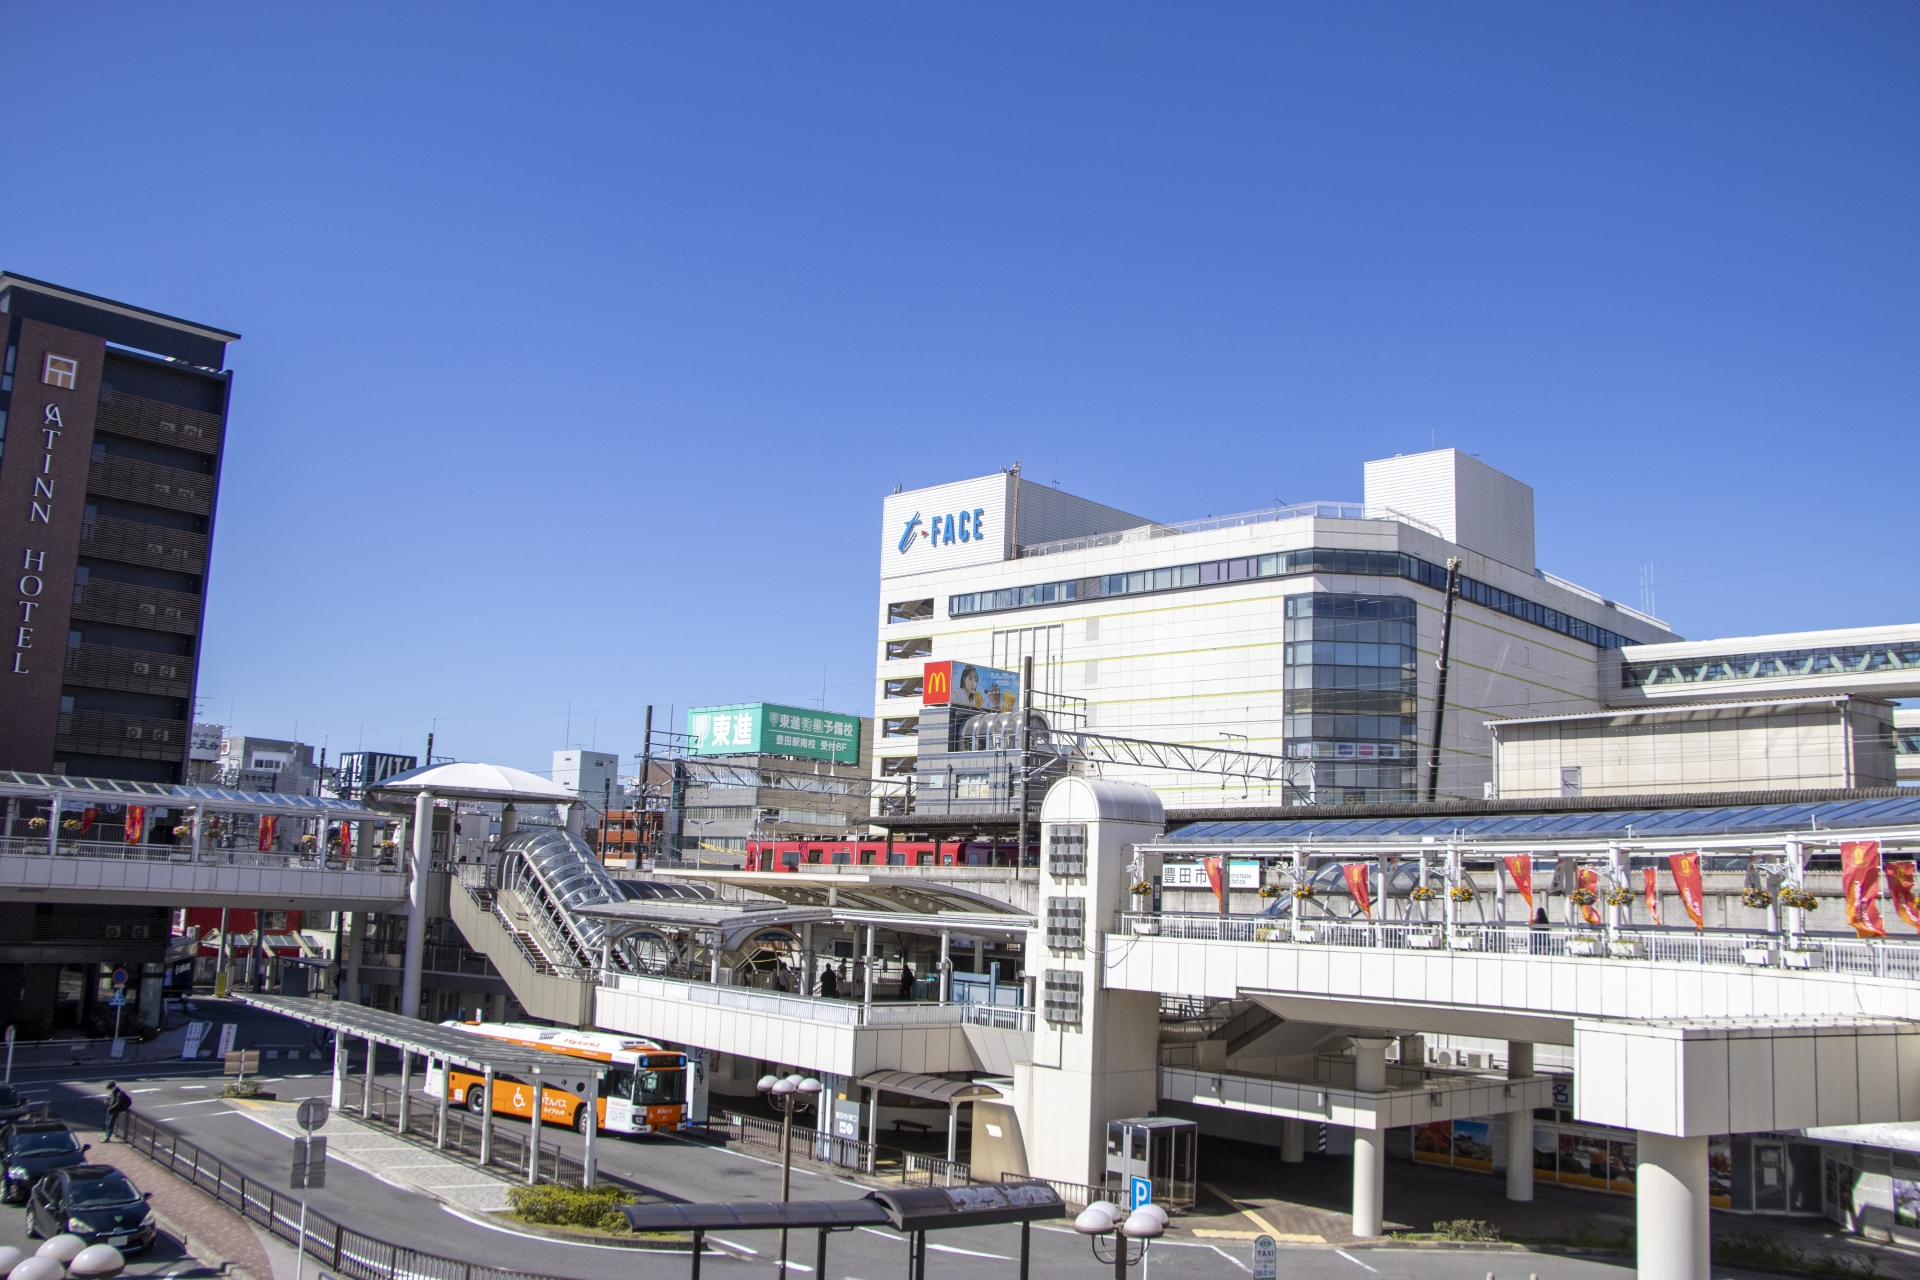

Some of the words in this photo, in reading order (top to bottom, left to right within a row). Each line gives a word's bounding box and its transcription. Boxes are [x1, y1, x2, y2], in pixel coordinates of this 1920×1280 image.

[930, 508, 985, 547] FACE
[13, 549, 46, 674] HOTEL
[711, 712, 753, 747] 東進
[779, 713, 854, 737] 東進衛星予備校
[775, 734, 816, 750] 豊田駅南校
[1344, 794, 1364, 805] GU
[563, 1038, 601, 1048] Hybrid
[697, 1048, 704, 1058] 2
[1552, 1084, 1569, 1103] 名
[1135, 1181, 1148, 1209] P
